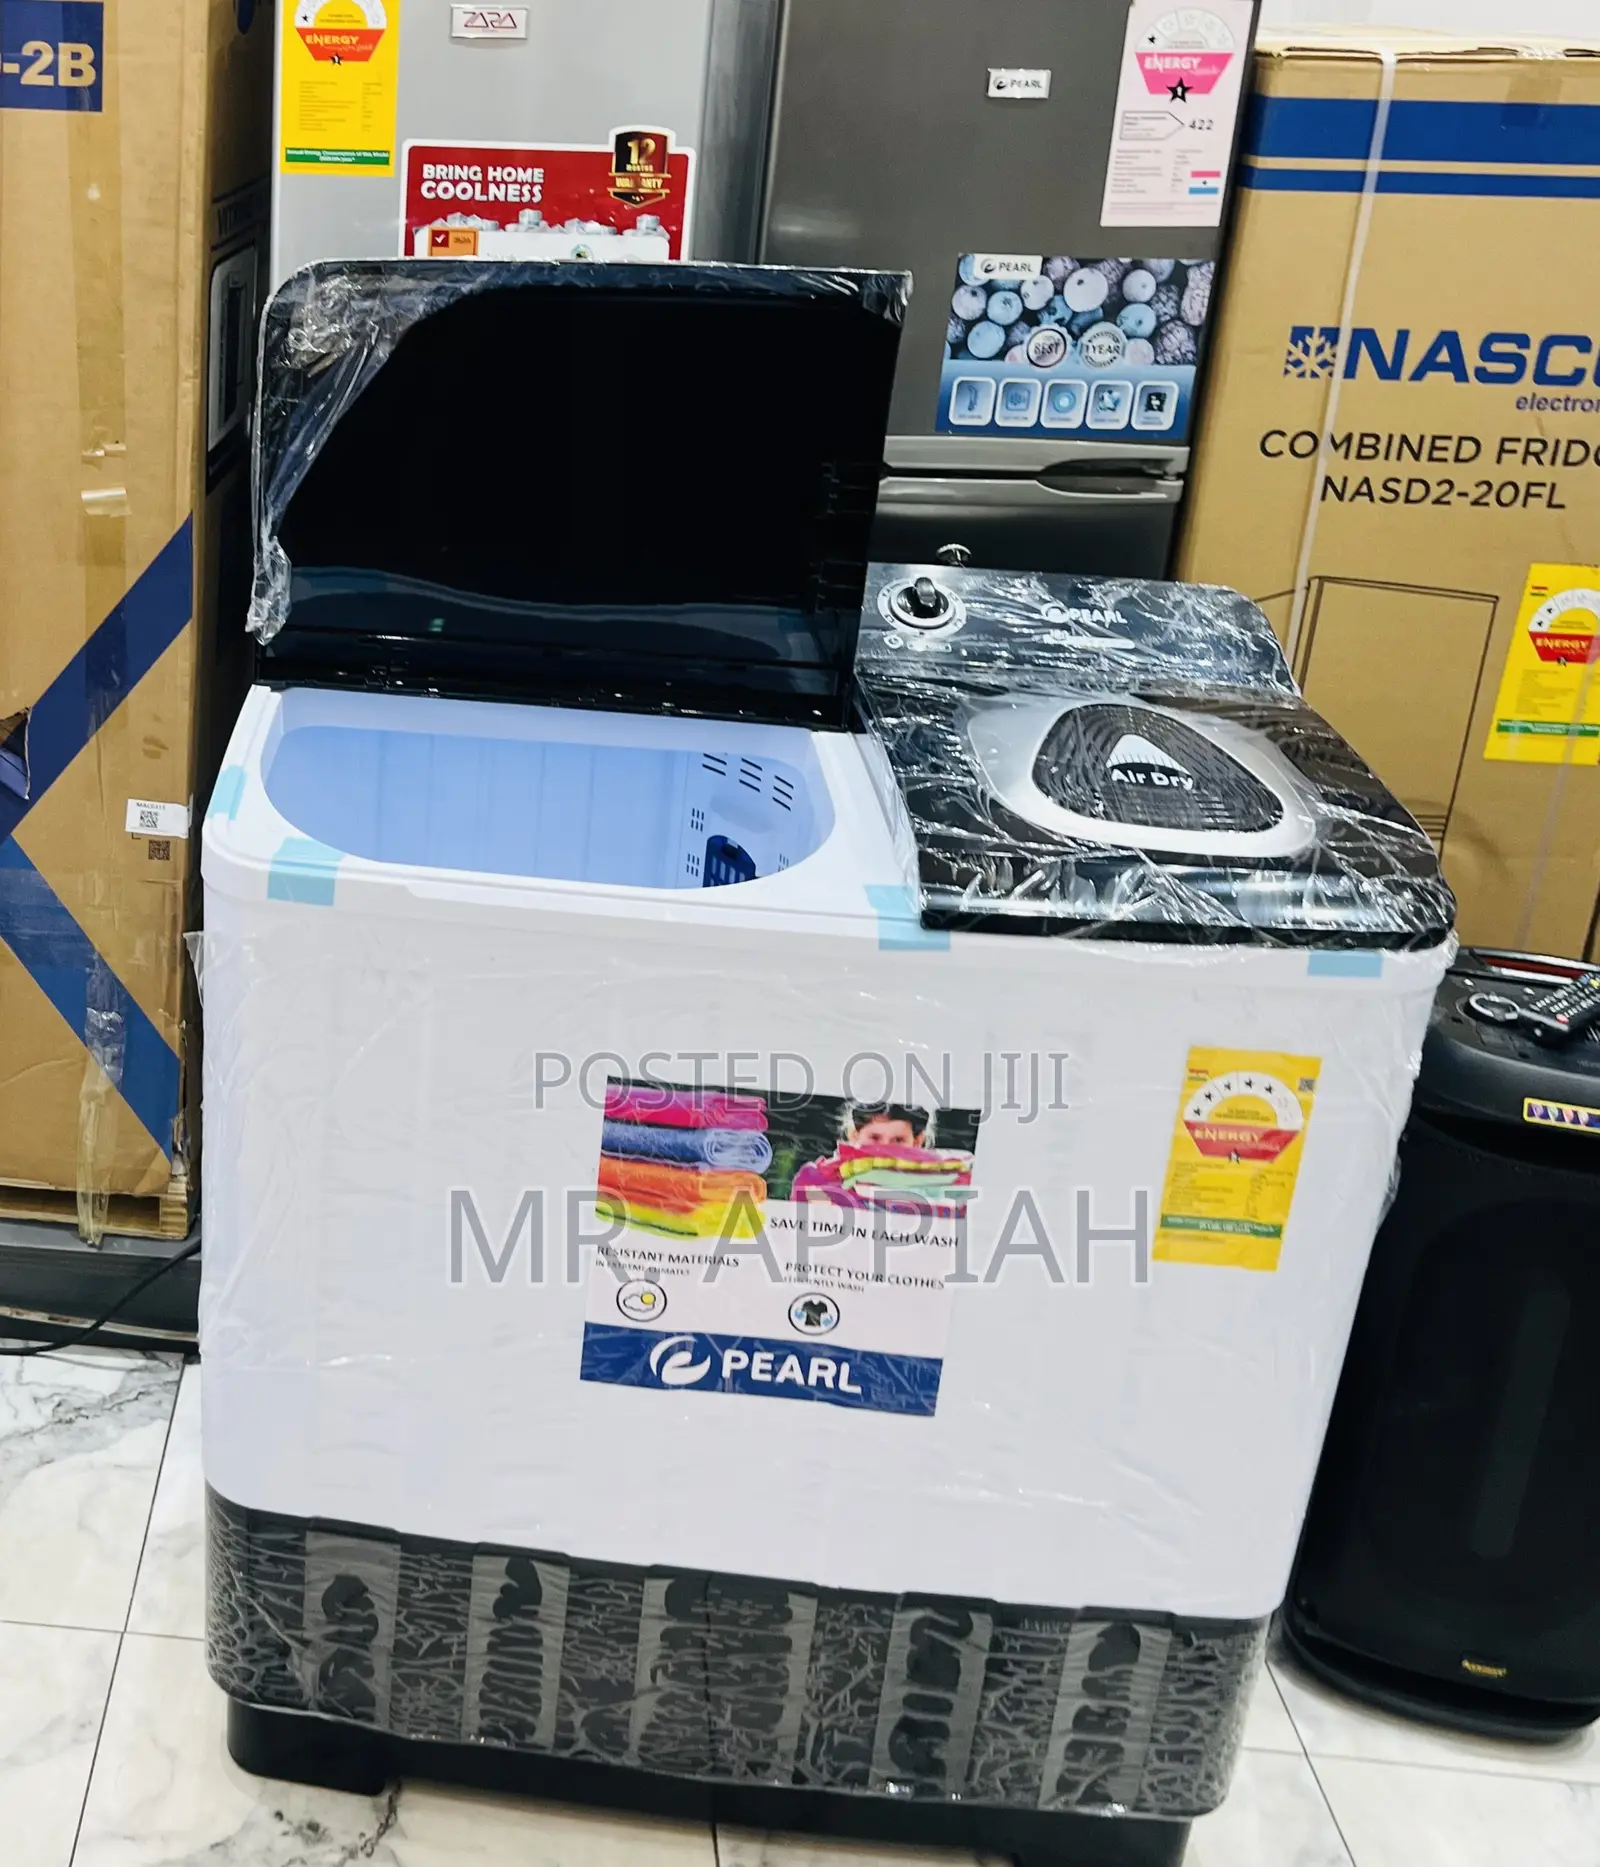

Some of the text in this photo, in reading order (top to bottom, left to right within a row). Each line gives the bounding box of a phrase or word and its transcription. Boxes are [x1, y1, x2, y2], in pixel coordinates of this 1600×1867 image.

[304, 33, 360, 47] ENERGY
[0, 40, 97, 87] -2B
[1143, 53, 1202, 72] ENERGY
[1188, 118, 1215, 131] 422
[627, 138, 657, 165] 12
[422, 163, 545, 184] BRING HOME
[420, 181, 543, 203] COOLNESS
[999, 261, 1034, 272] PEARL
[1092, 343, 1120, 355] YEAR
[1342, 326, 1600, 388] NASC
[1259, 429, 1482, 464] COMBINED
[1320, 475, 1566, 509] NASD2-20FL
[1535, 637, 1590, 650] ENERGY
[1110, 767, 1194, 791] Air Dry
[1194, 1126, 1261, 1144] ENERGY
[770, 1217, 960, 1249] SAVE TIME IN EACH WASH
[597, 1246, 740, 1267] RESISTANT MATERIALS
[785, 1261, 945, 1290] PROTECT YOUR CLOTHES
[720, 1348, 862, 1396] PEARL
